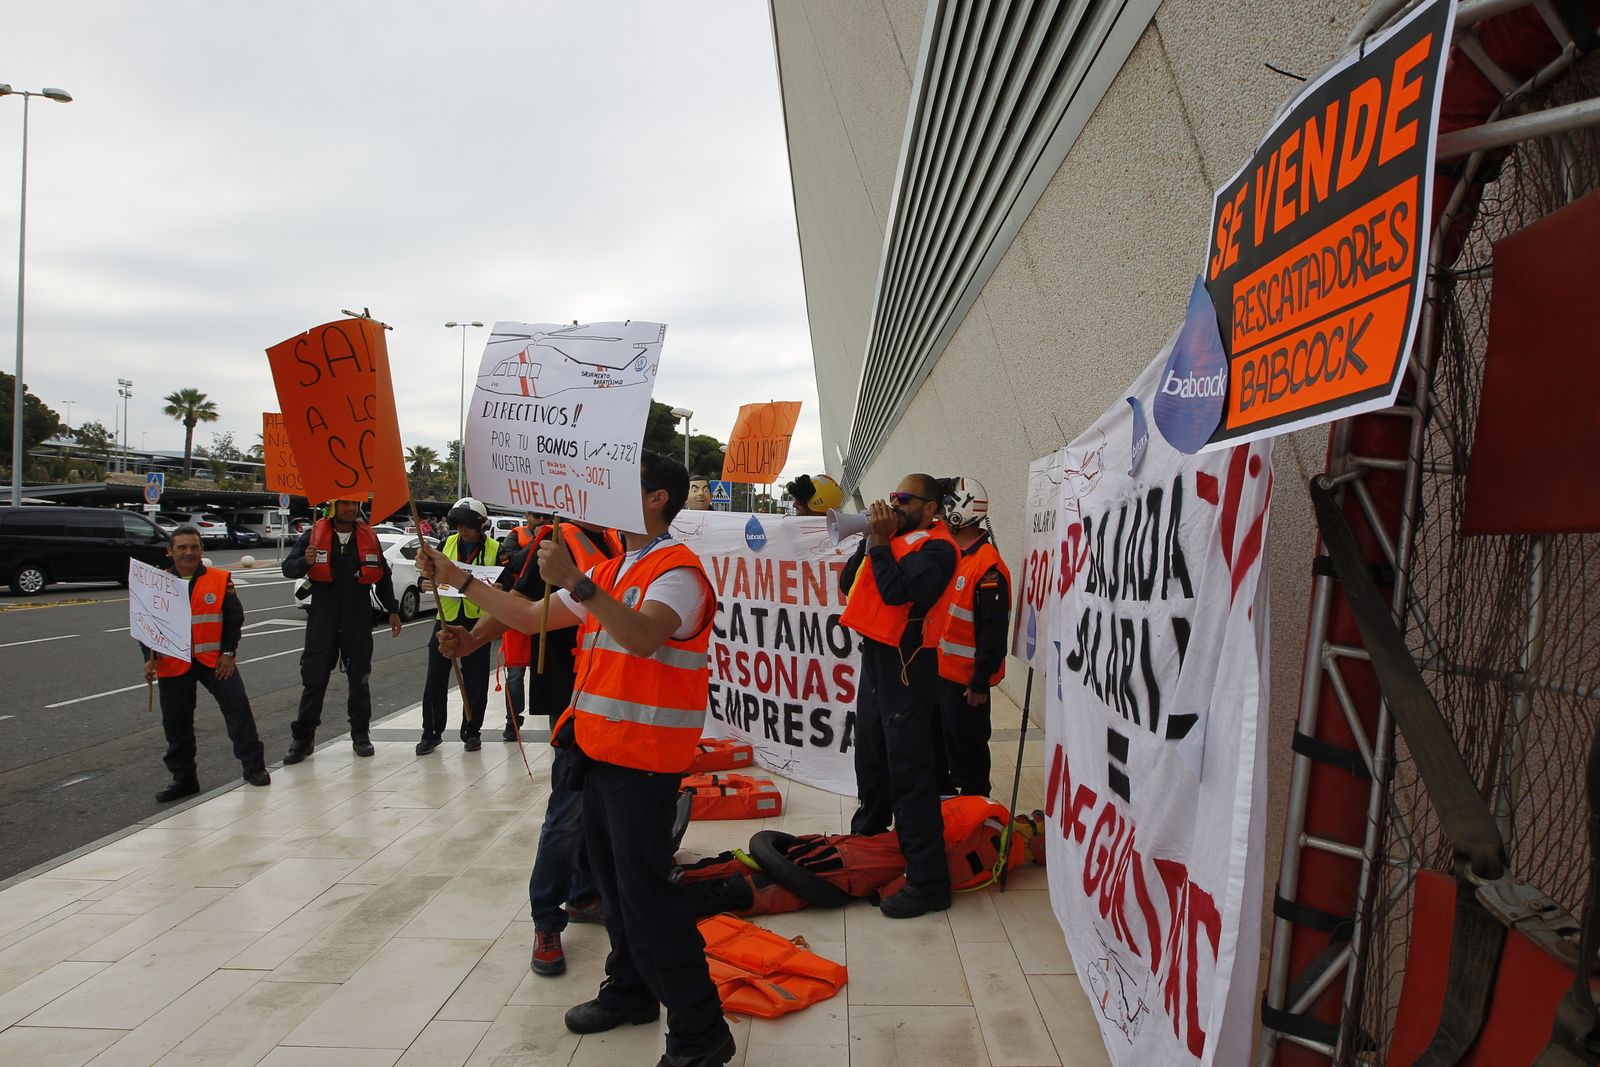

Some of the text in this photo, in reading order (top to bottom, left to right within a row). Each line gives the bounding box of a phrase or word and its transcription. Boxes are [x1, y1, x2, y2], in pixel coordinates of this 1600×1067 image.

[1210, 32, 1433, 281] SE VENDE
[1233, 201, 1409, 341] RESCATADORES
[1239, 312, 1374, 412] BABCOCK
[1162, 368, 1226, 398] babcock
[306, 406, 328, 435] A
[491, 431, 510, 448] POR
[517, 433, 528, 451] TU
[537, 435, 578, 458] BONUS
[492, 453, 532, 475] NUESTRA
[132, 564, 179, 597] RECORTES
[153, 594, 170, 613] EN
[713, 601, 864, 659] CATAMO
